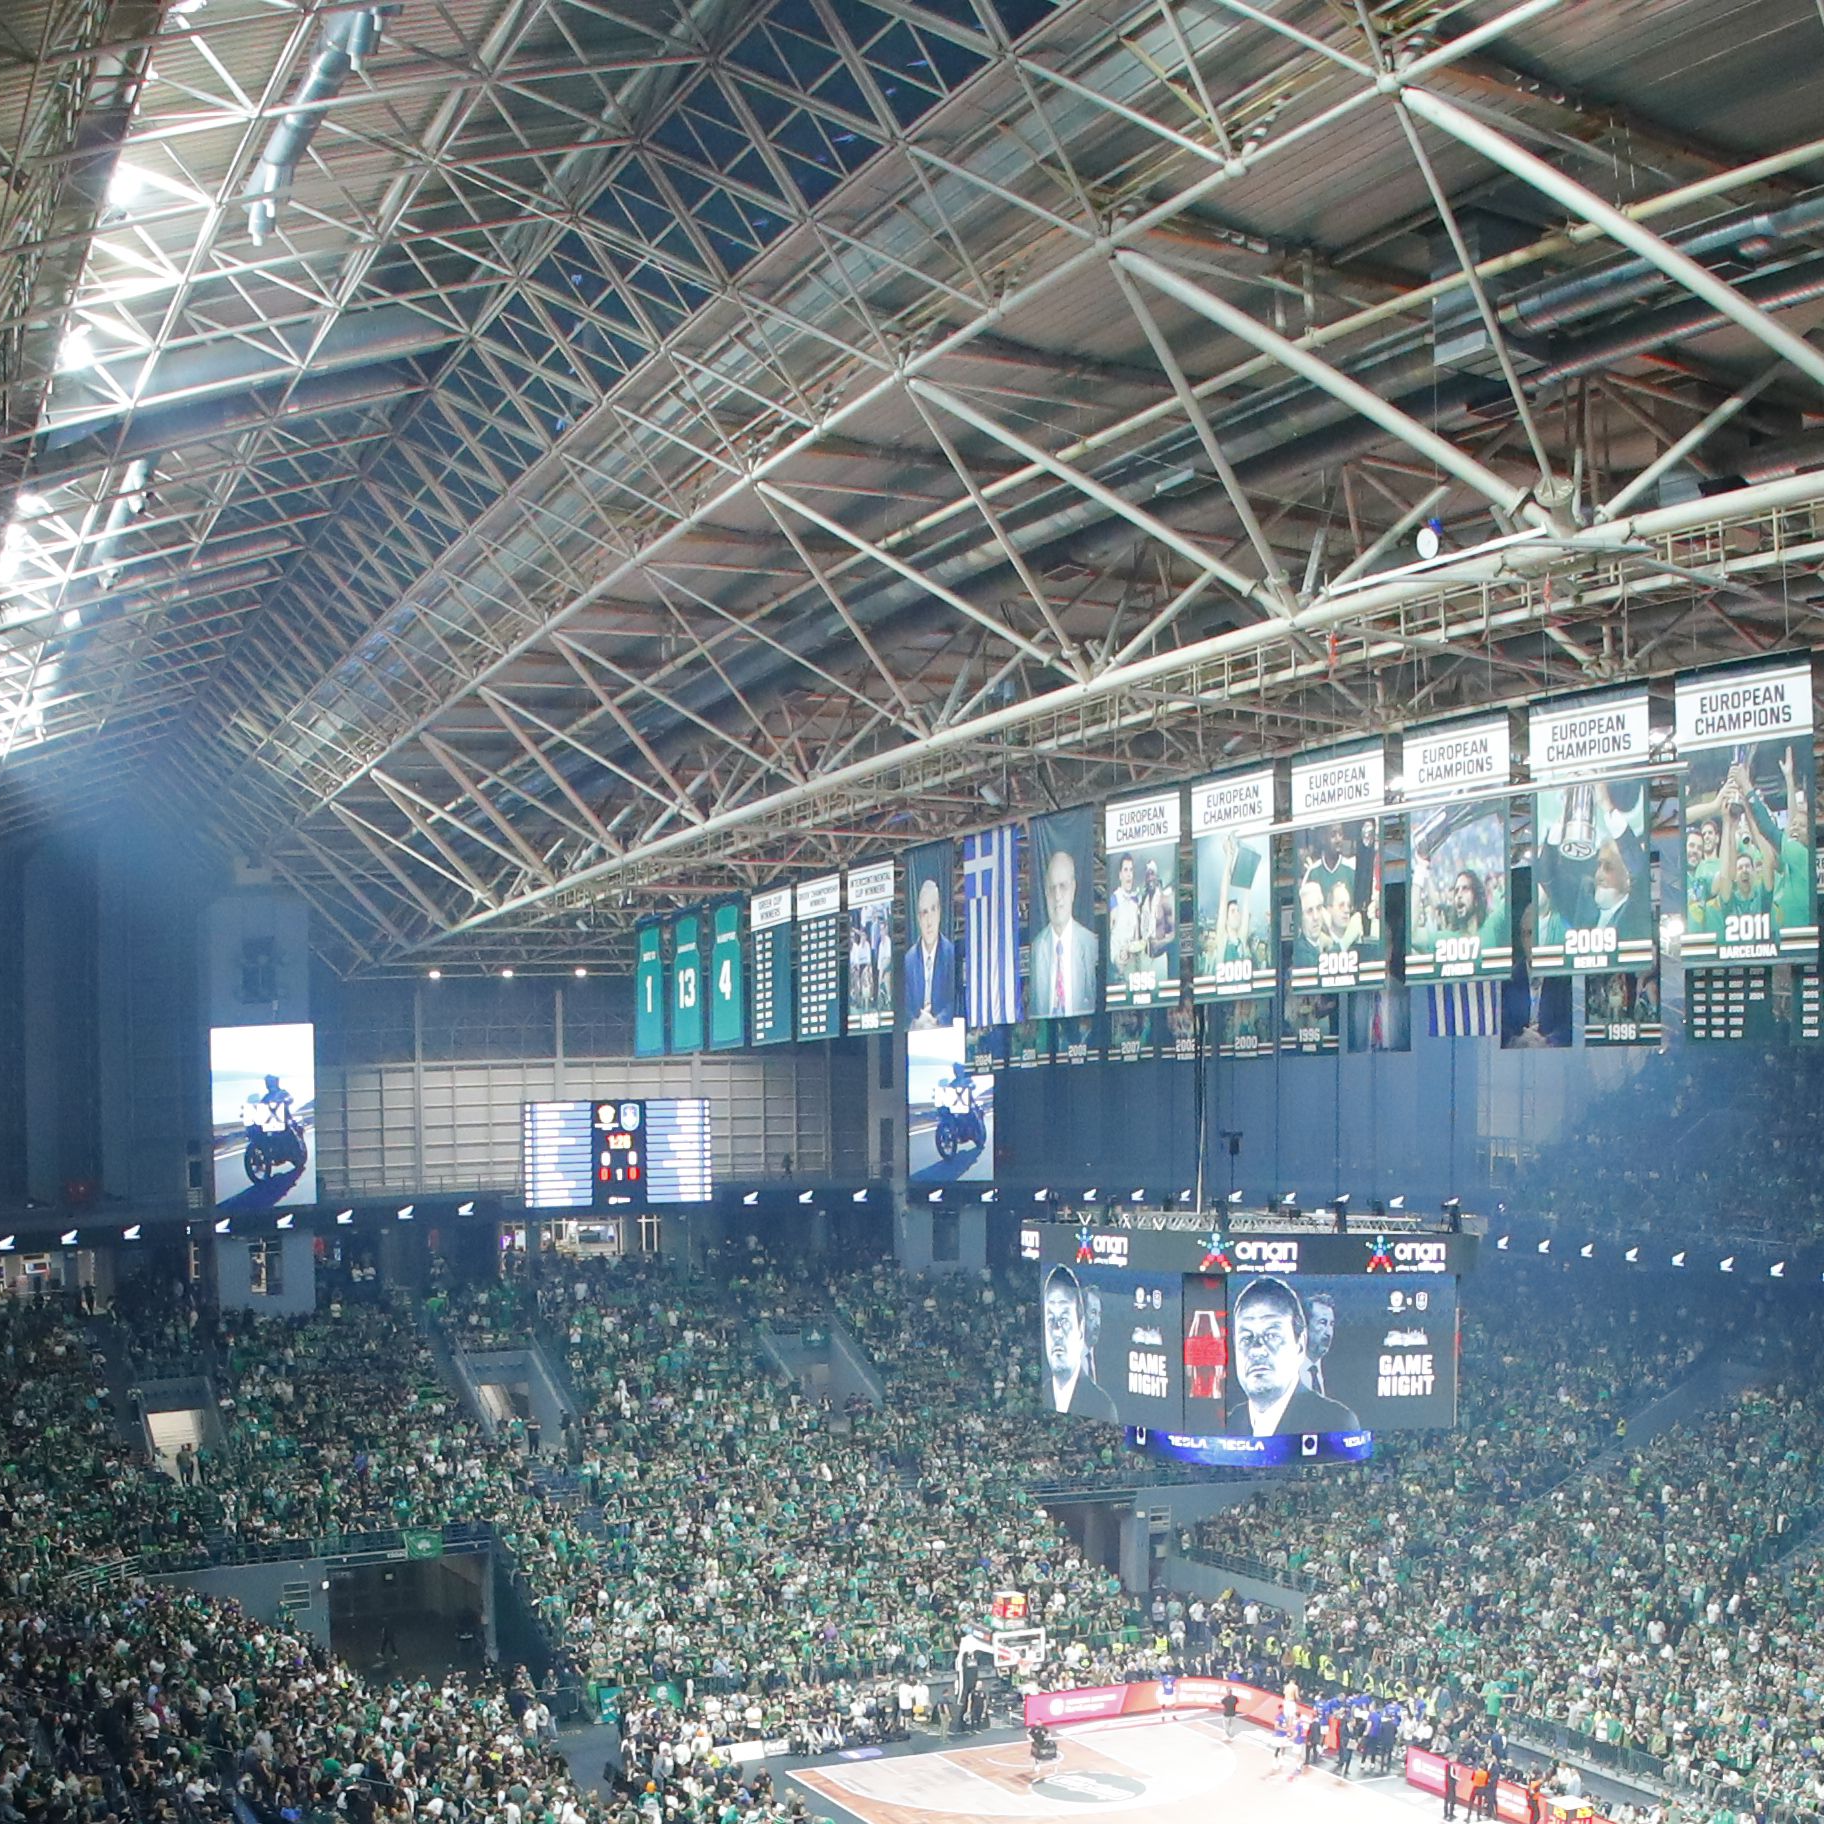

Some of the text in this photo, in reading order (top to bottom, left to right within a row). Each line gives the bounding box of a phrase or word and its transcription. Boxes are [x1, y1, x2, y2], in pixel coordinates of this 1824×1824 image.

[1700, 684, 1785, 714] EUROPEAN
[1551, 714, 1626, 742] EUROPEAN
[1695, 705, 1792, 736] CHAMPIONS
[1422, 738, 1488, 764] EUROPEAN
[1547, 733, 1631, 762] CHAMPIONS
[1309, 765, 1366, 790] EUROPEAN
[1419, 756, 1493, 783] CHAMPIONS
[1207, 785, 1260, 808] EUROPEAN
[1304, 783, 1370, 808] CHAMPIONS
[1119, 806, 1165, 826] EUROPEAN
[1203, 801, 1263, 825] CHAMPIONS
[1116, 821, 1169, 842] CHAMPIONS
[1725, 913, 1771, 942] 2011
[1435, 936, 1480, 962] 2007
[1565, 927, 1617, 955] 2009
[1719, 943, 1778, 960] BARCELONA
[1216, 960, 1252, 983] 2000
[1318, 950, 1358, 975] 2002
[678, 968, 695, 1009] 13
[719, 960, 731, 1000] 4
[1129, 971, 1156, 992] 1996
[646, 975, 653, 1013] 1
[1235, 1036, 1258, 1049] 2000
[1299, 1028, 1320, 1042] 1996
[1608, 1023, 1637, 1040] 1996
[1121, 1041, 1140, 1053] 2007
[1129, 1351, 1166, 1376] GAME
[1379, 1354, 1433, 1375] GAME
[1129, 1372, 1168, 1398] NIGHT
[1377, 1375, 1435, 1396] NIGHT
[1168, 1435, 1264, 1451] TESLA TESLA
